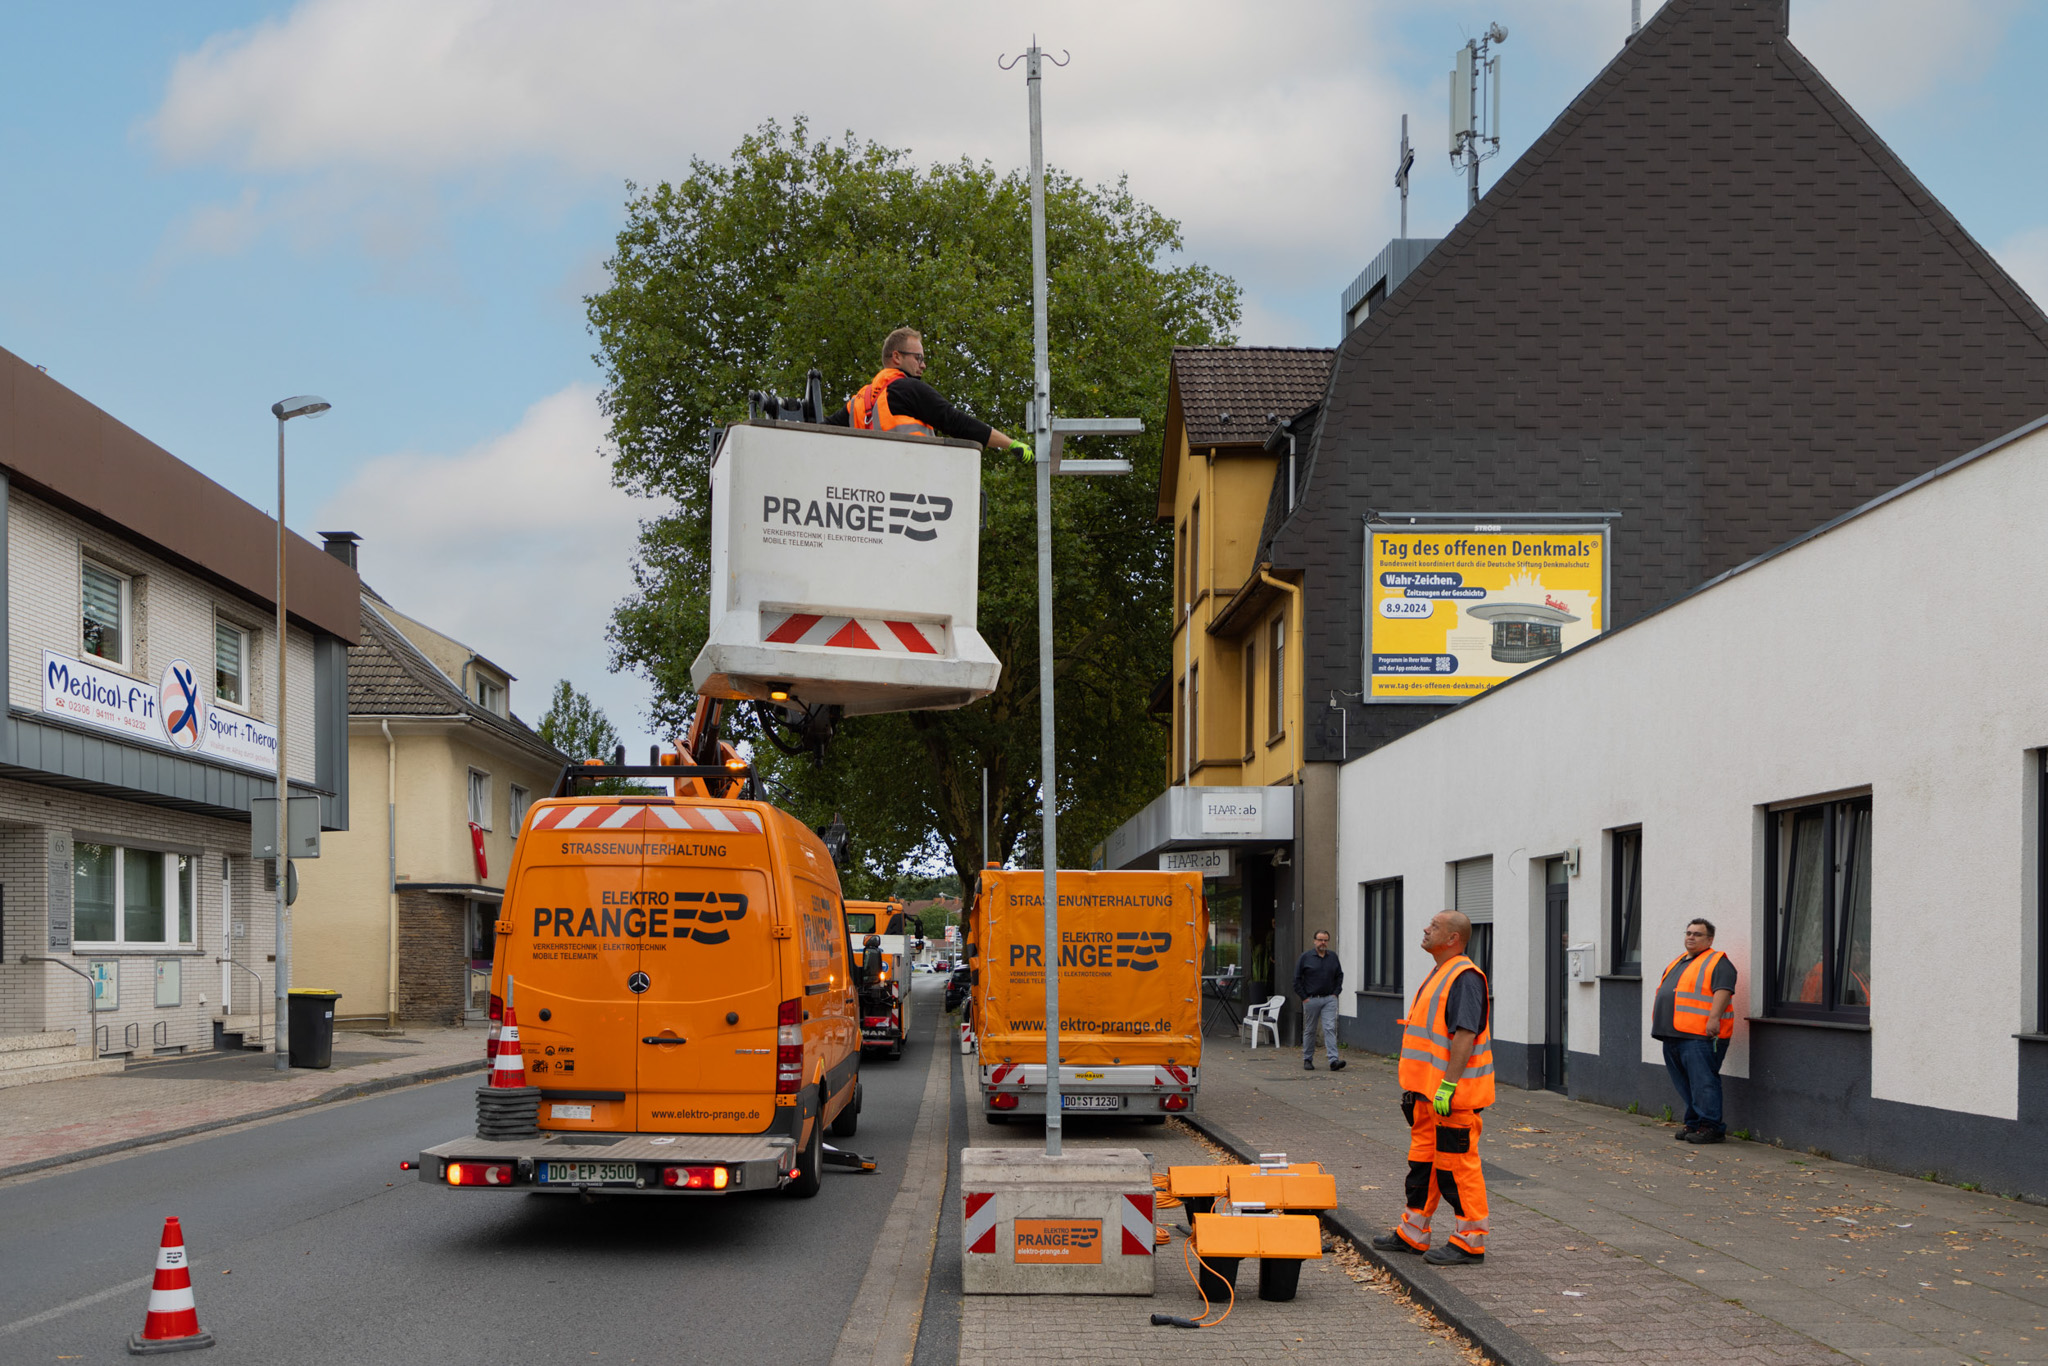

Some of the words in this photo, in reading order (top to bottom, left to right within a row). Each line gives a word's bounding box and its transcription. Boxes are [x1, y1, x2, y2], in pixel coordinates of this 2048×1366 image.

[826, 486, 885, 503] ELEKTRO
[763, 496, 884, 533] PRANGE
[762, 528, 823, 540] VERKEHRSTECHNIK
[827, 534, 884, 545] ELEKTROTECHNIK
[762, 537, 787, 546] MOBILE
[789, 539, 823, 548] TELEMATIK
[1380, 540, 1408, 559] Tag
[1413, 540, 1440, 556] des
[1444, 540, 1506, 556] offenen
[1517, 561, 1542, 569] Stiftung
[1386, 574, 1456, 585] Wahr-Zeichen.
[1406, 589, 1440, 598] Zeitzeugen
[1452, 589, 1484, 597] Geschichte
[1386, 603, 1427, 613] 8.9.2024
[1396, 665, 1405, 673] App
[48, 661, 155, 718] Medical-Fit
[68, 701, 90, 715] 02306
[124, 716, 146, 730] 943232
[209, 712, 238, 739] Sport
[55, 840, 64, 853] 63
[561, 843, 727, 857] STRASSENUNTERHALTUNG
[602, 891, 669, 905] ELEKTRO
[1009, 895, 1173, 907] STRAENUNTERHALTUNG
[534, 908, 668, 938] PRANGE
[1062, 932, 1113, 943] ELEKTRO
[533, 943, 597, 951] VERKEHRSTECHNIK
[603, 943, 667, 951] ELEKTROTECHNIK
[532, 952, 558, 960] MOBILE
[560, 952, 598, 960] TELEMATIK
[1009, 944, 1113, 967] PRNGE
[1009, 1017, 1172, 1034] www.ektro-prange.de
[1065, 1096, 1076, 1106] DO
[1082, 1096, 1094, 1106] ST
[1095, 1096, 1117, 1106] 1230
[651, 1109, 760, 1121] www.elektro-prange.de
[549, 1164, 567, 1180] DO
[578, 1164, 596, 1180] EP
[600, 1164, 635, 1180] 3500
[1018, 1234, 1069, 1246] PRANGE
[1018, 1248, 1069, 1256] elektro-prange.de
